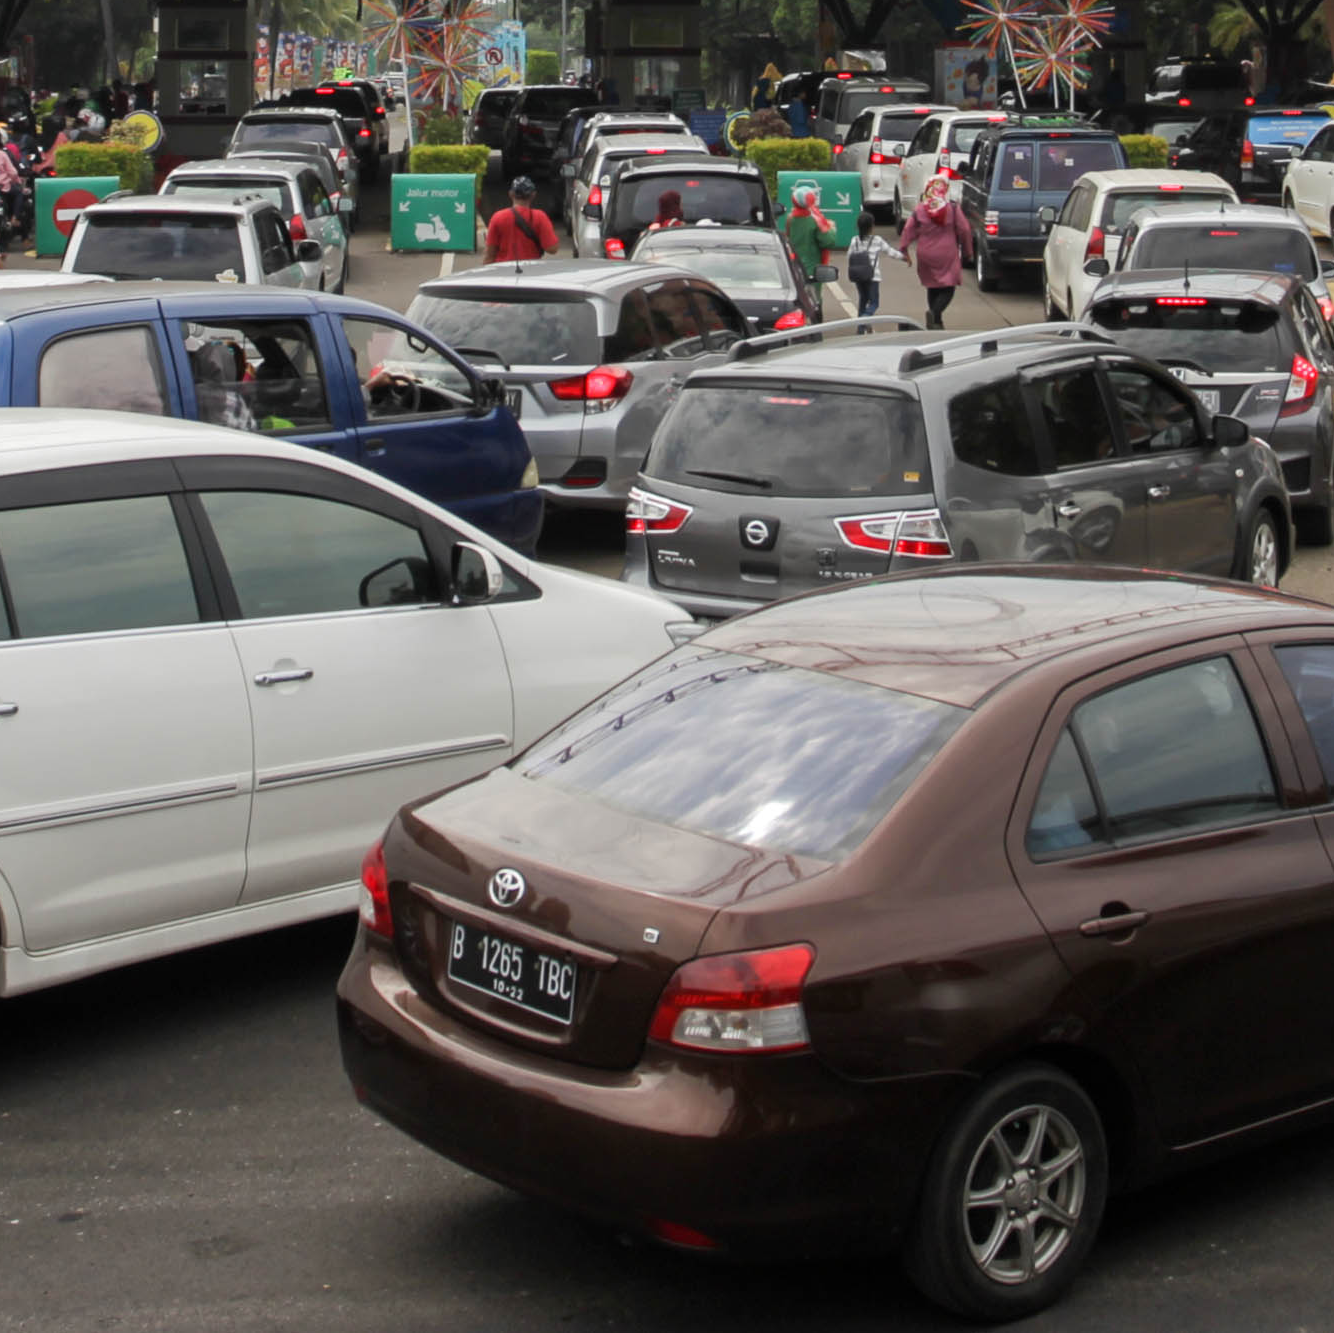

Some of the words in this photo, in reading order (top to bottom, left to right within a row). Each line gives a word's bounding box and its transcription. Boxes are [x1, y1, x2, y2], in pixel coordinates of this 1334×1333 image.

[406, 188, 428, 198] Jalur
[453, 925, 465, 959] B
[481, 936, 523, 982] 1265
[538, 954, 572, 1000] TBC
